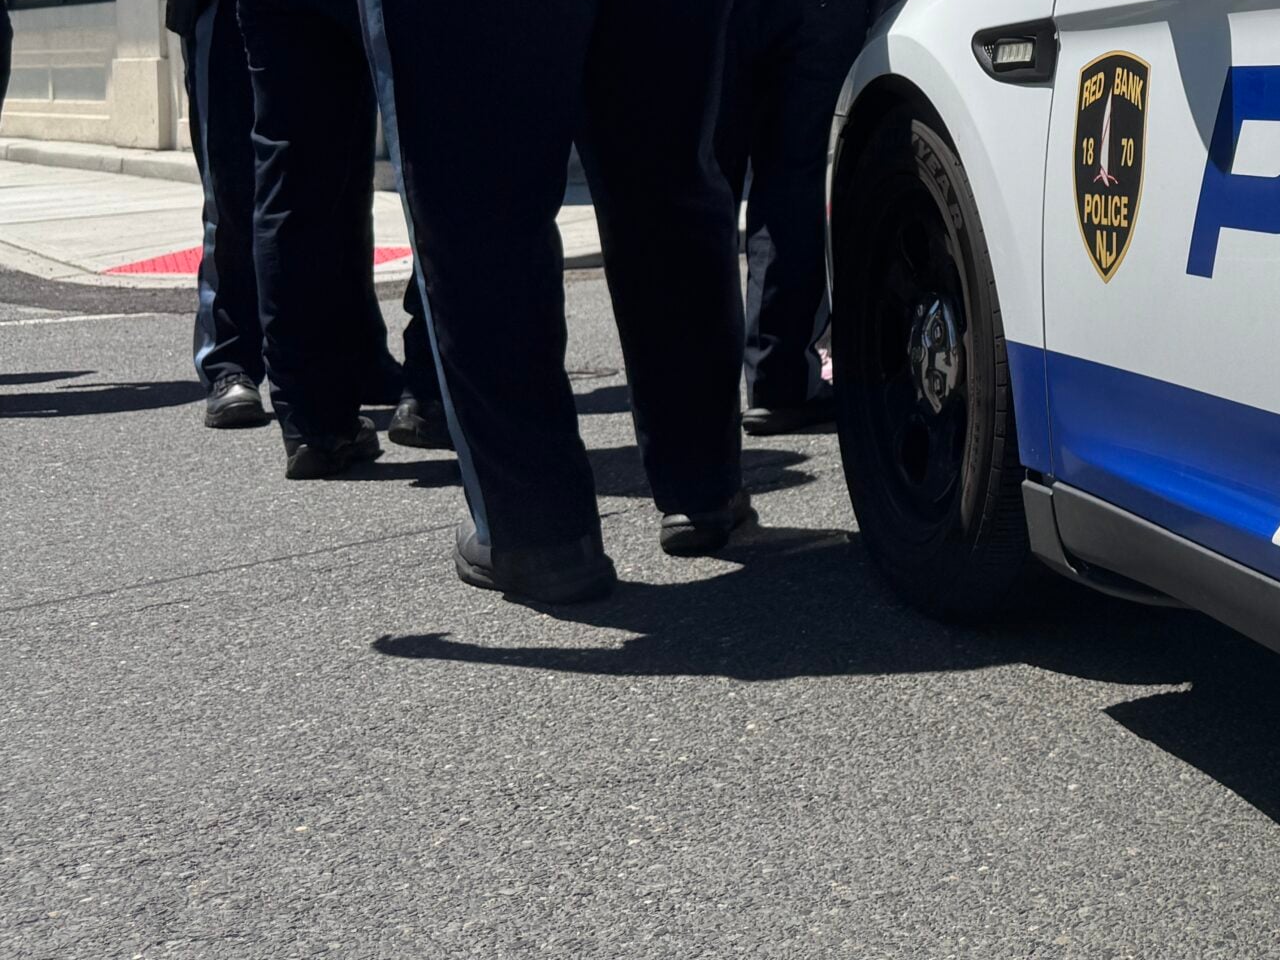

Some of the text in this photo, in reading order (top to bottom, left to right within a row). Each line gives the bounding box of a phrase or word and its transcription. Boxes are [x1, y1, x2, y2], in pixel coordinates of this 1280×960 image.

[1082, 66, 1143, 111] RED BANK
[1082, 137, 1134, 167] 18 70
[911, 131, 965, 230] YEAR
[1083, 193, 1129, 228] POLICE
[1096, 230, 1117, 268] NJ
